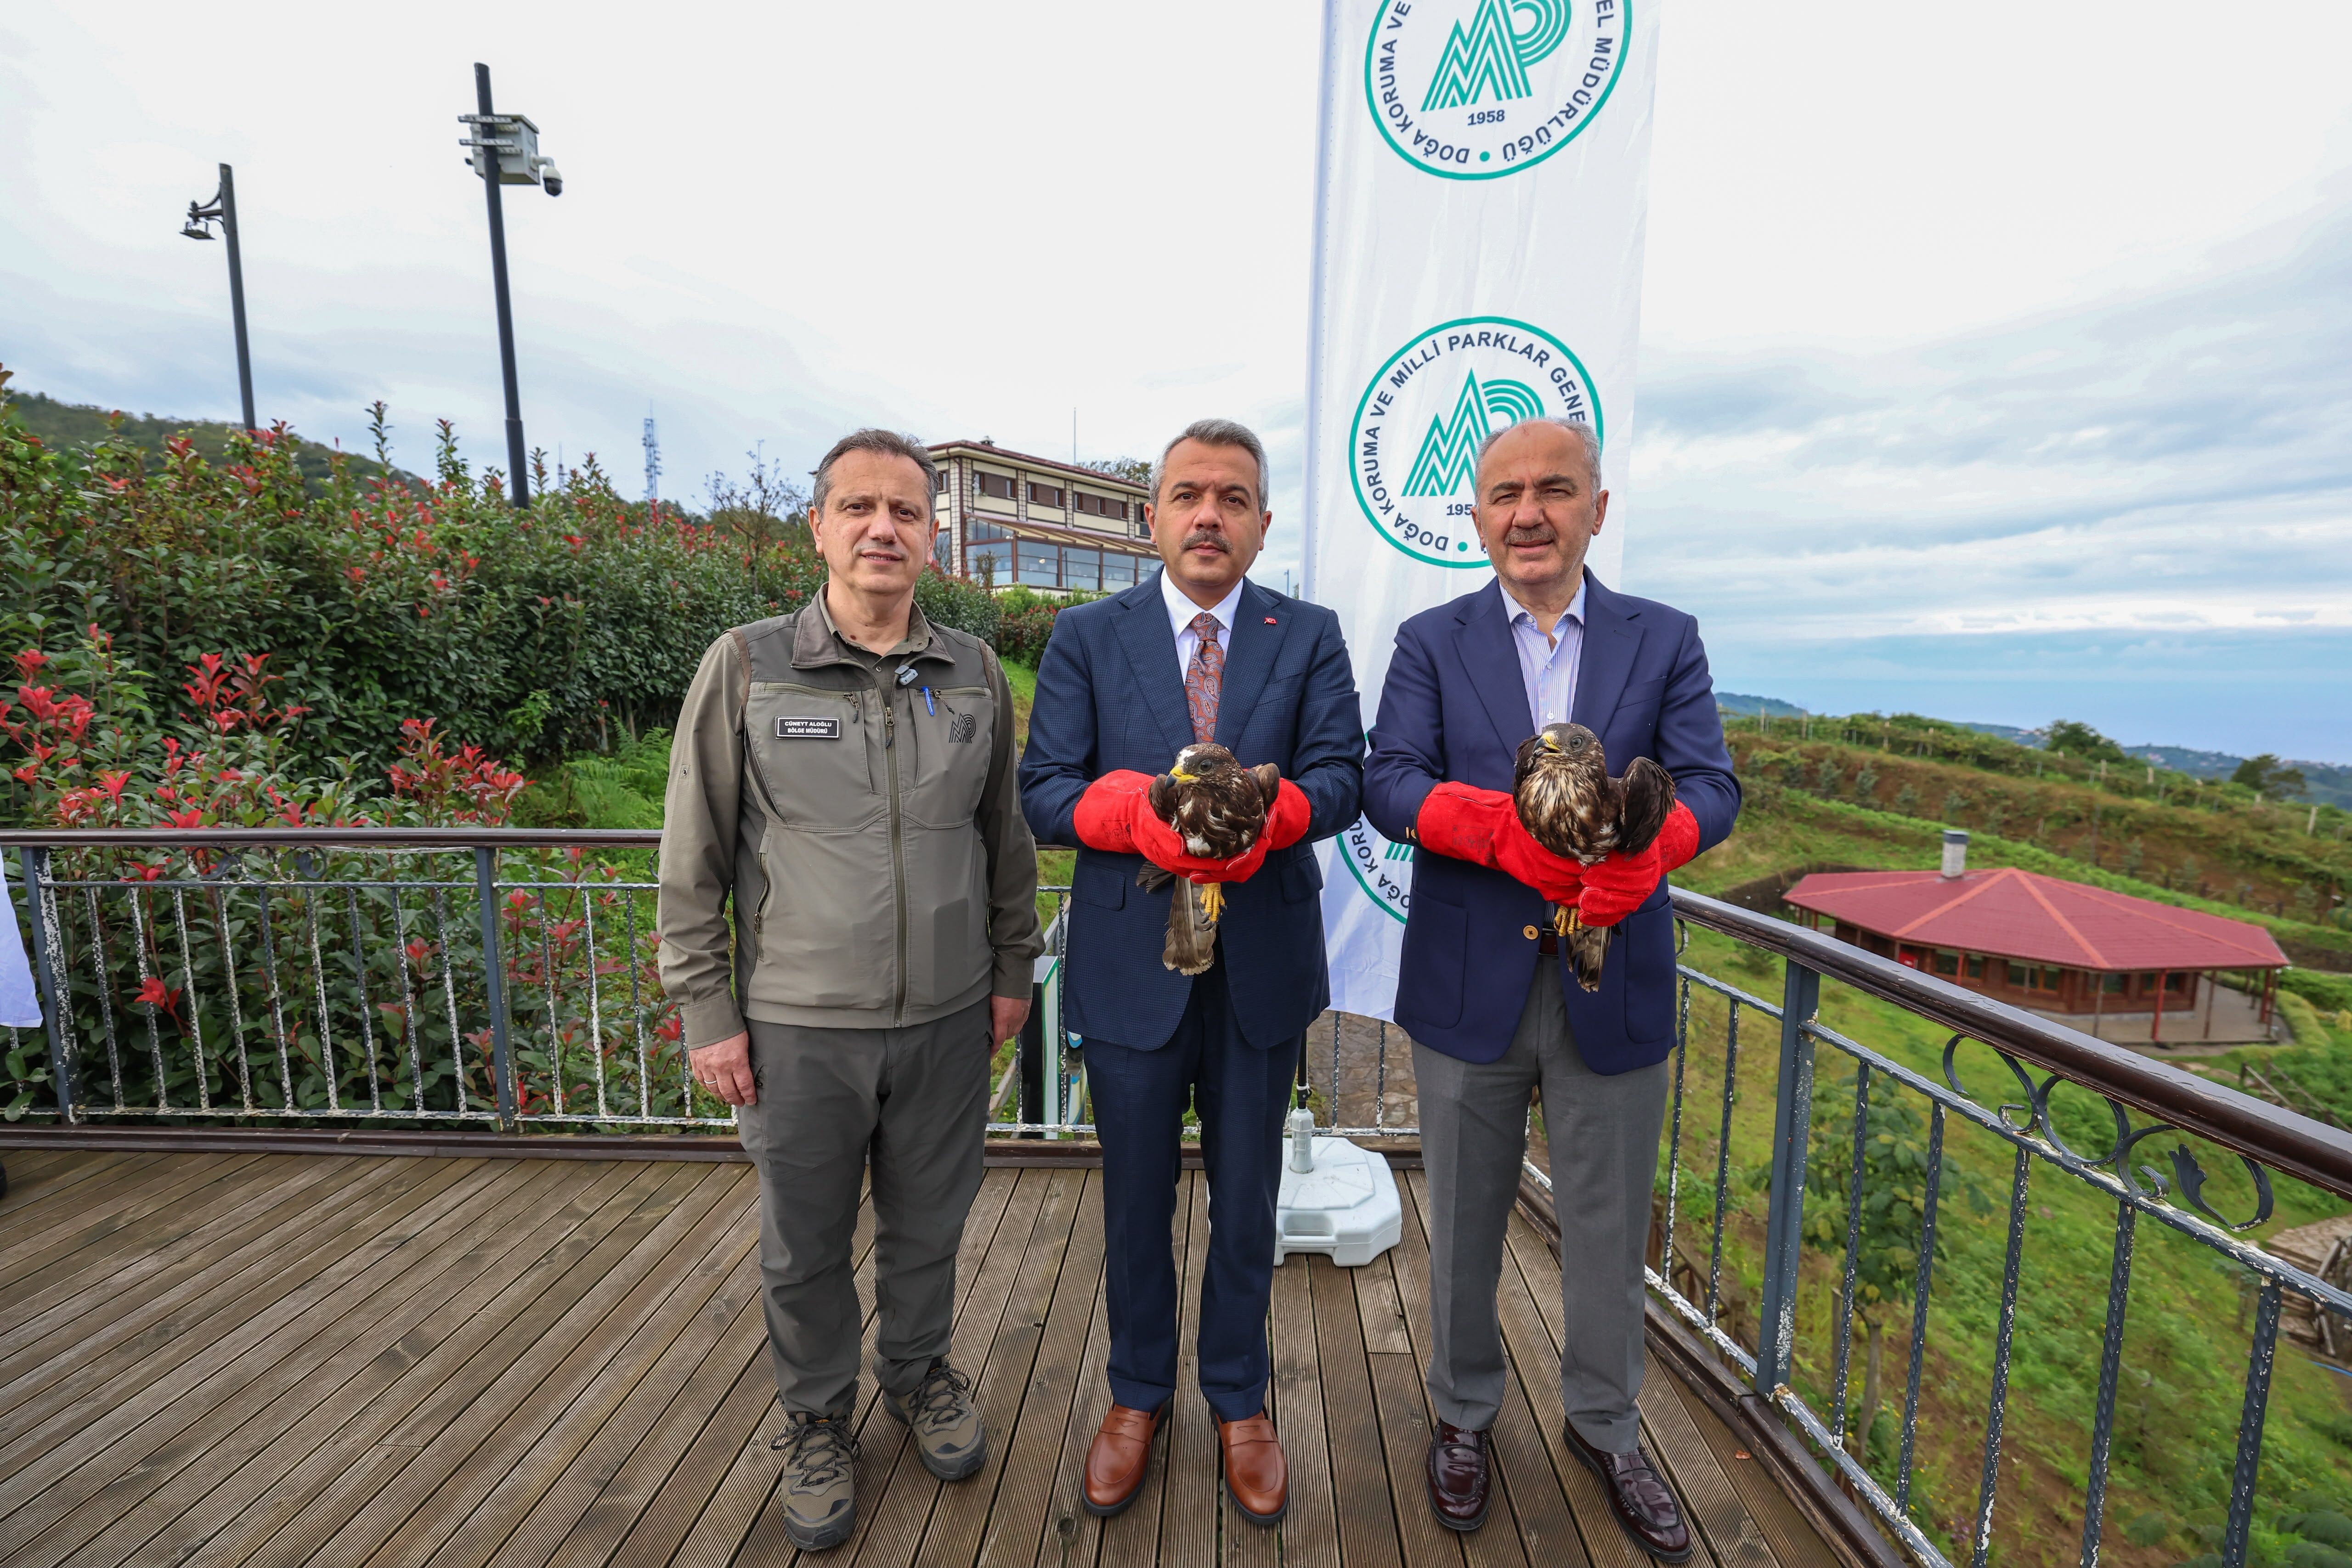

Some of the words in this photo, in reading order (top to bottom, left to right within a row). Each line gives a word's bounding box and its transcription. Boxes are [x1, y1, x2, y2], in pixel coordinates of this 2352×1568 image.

[1386, 1, 1411, 29] VE
[1380, 39, 1413, 133] KORUMA
[1503, 38, 1613, 162] MÜDÜRLÜĞÜ
[1468, 110, 1505, 126] 1958
[1413, 129, 1470, 164] DOĞA
[1390, 339, 1441, 388] MİLLİ
[1448, 332, 1550, 368] PARKLAR
[1370, 391, 1394, 416] VE
[1550, 367, 1586, 422] GENE
[1363, 427, 1394, 515] KORUMA
[1447, 504, 1473, 515] 195
[1394, 512, 1449, 551] DOĞA
[1349, 820, 1379, 874] KORU
[1378, 874, 1409, 908] OĞA
